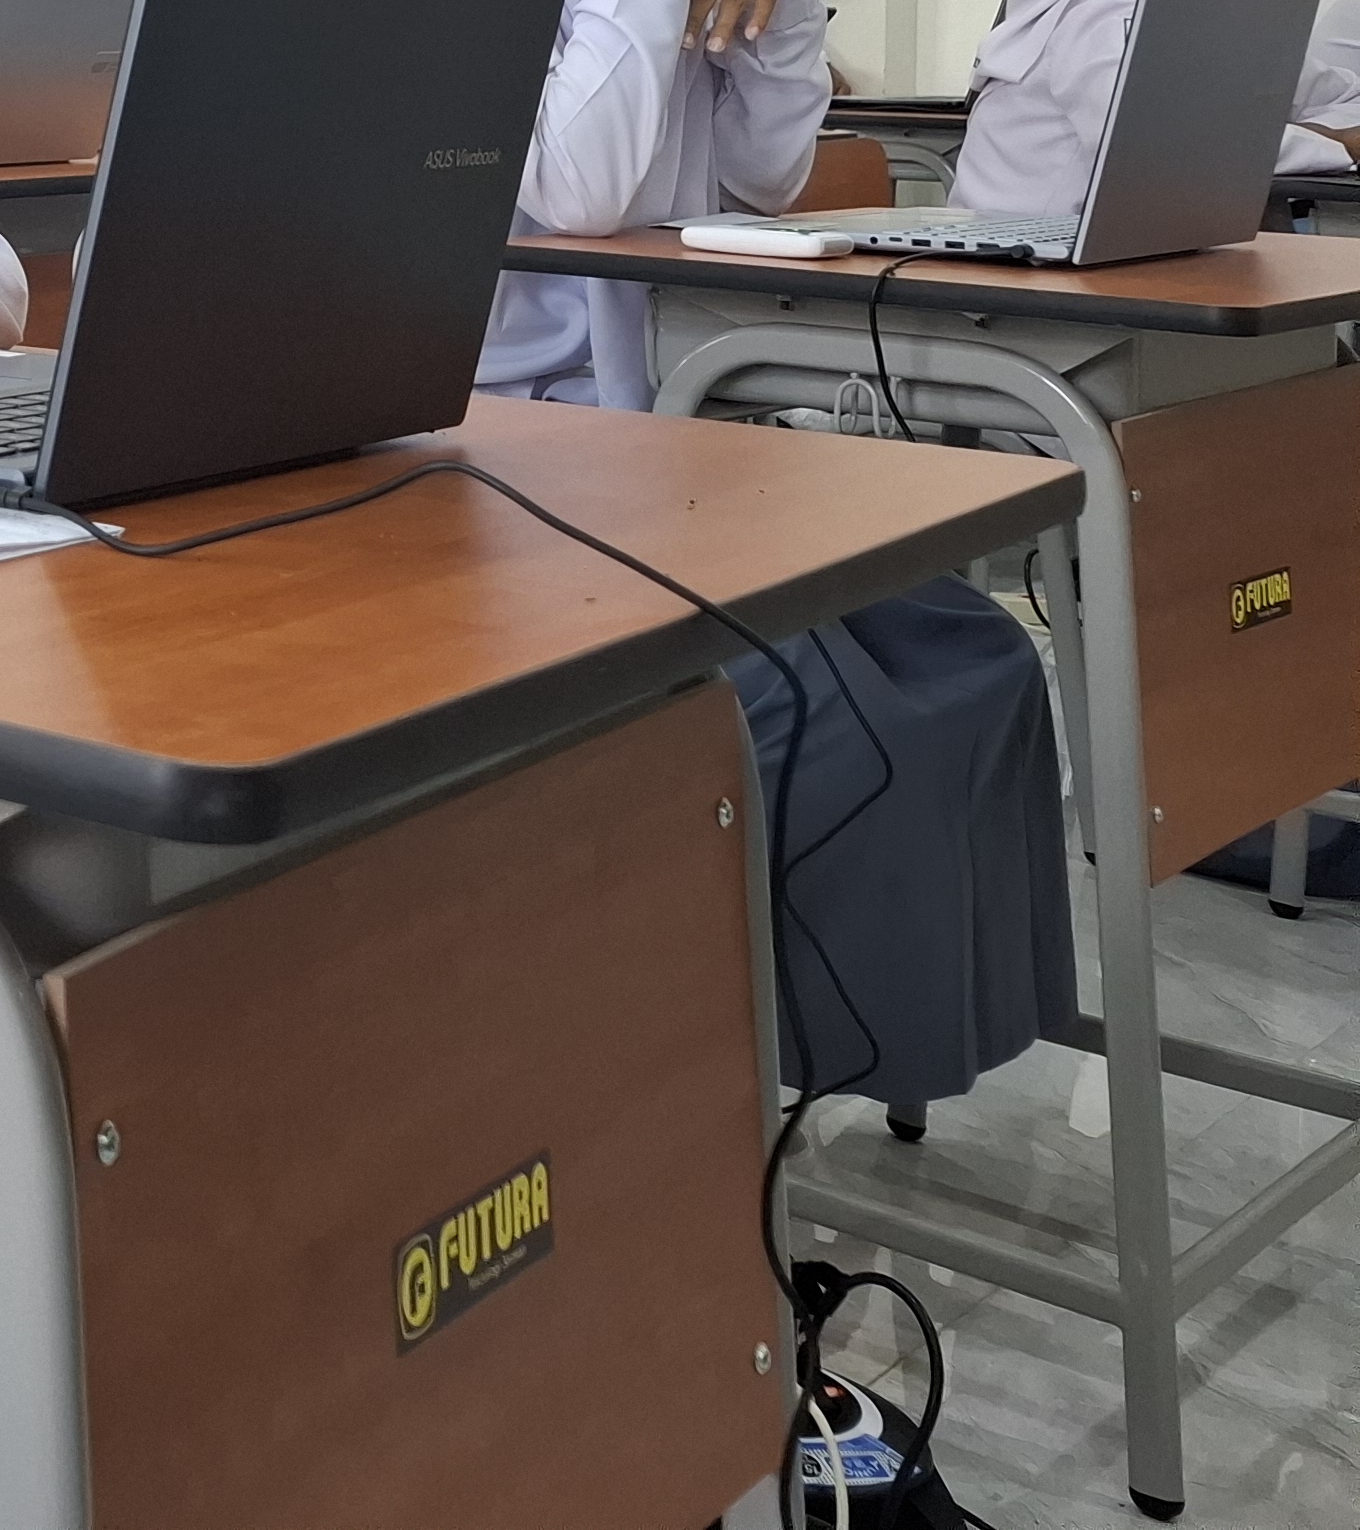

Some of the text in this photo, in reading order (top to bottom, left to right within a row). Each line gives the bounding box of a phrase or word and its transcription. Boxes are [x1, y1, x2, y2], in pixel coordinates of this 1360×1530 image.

[423, 149, 455, 170] ASUS
[1245, 570, 1291, 613] FUTURA
[439, 1161, 550, 1291] FUTURA
